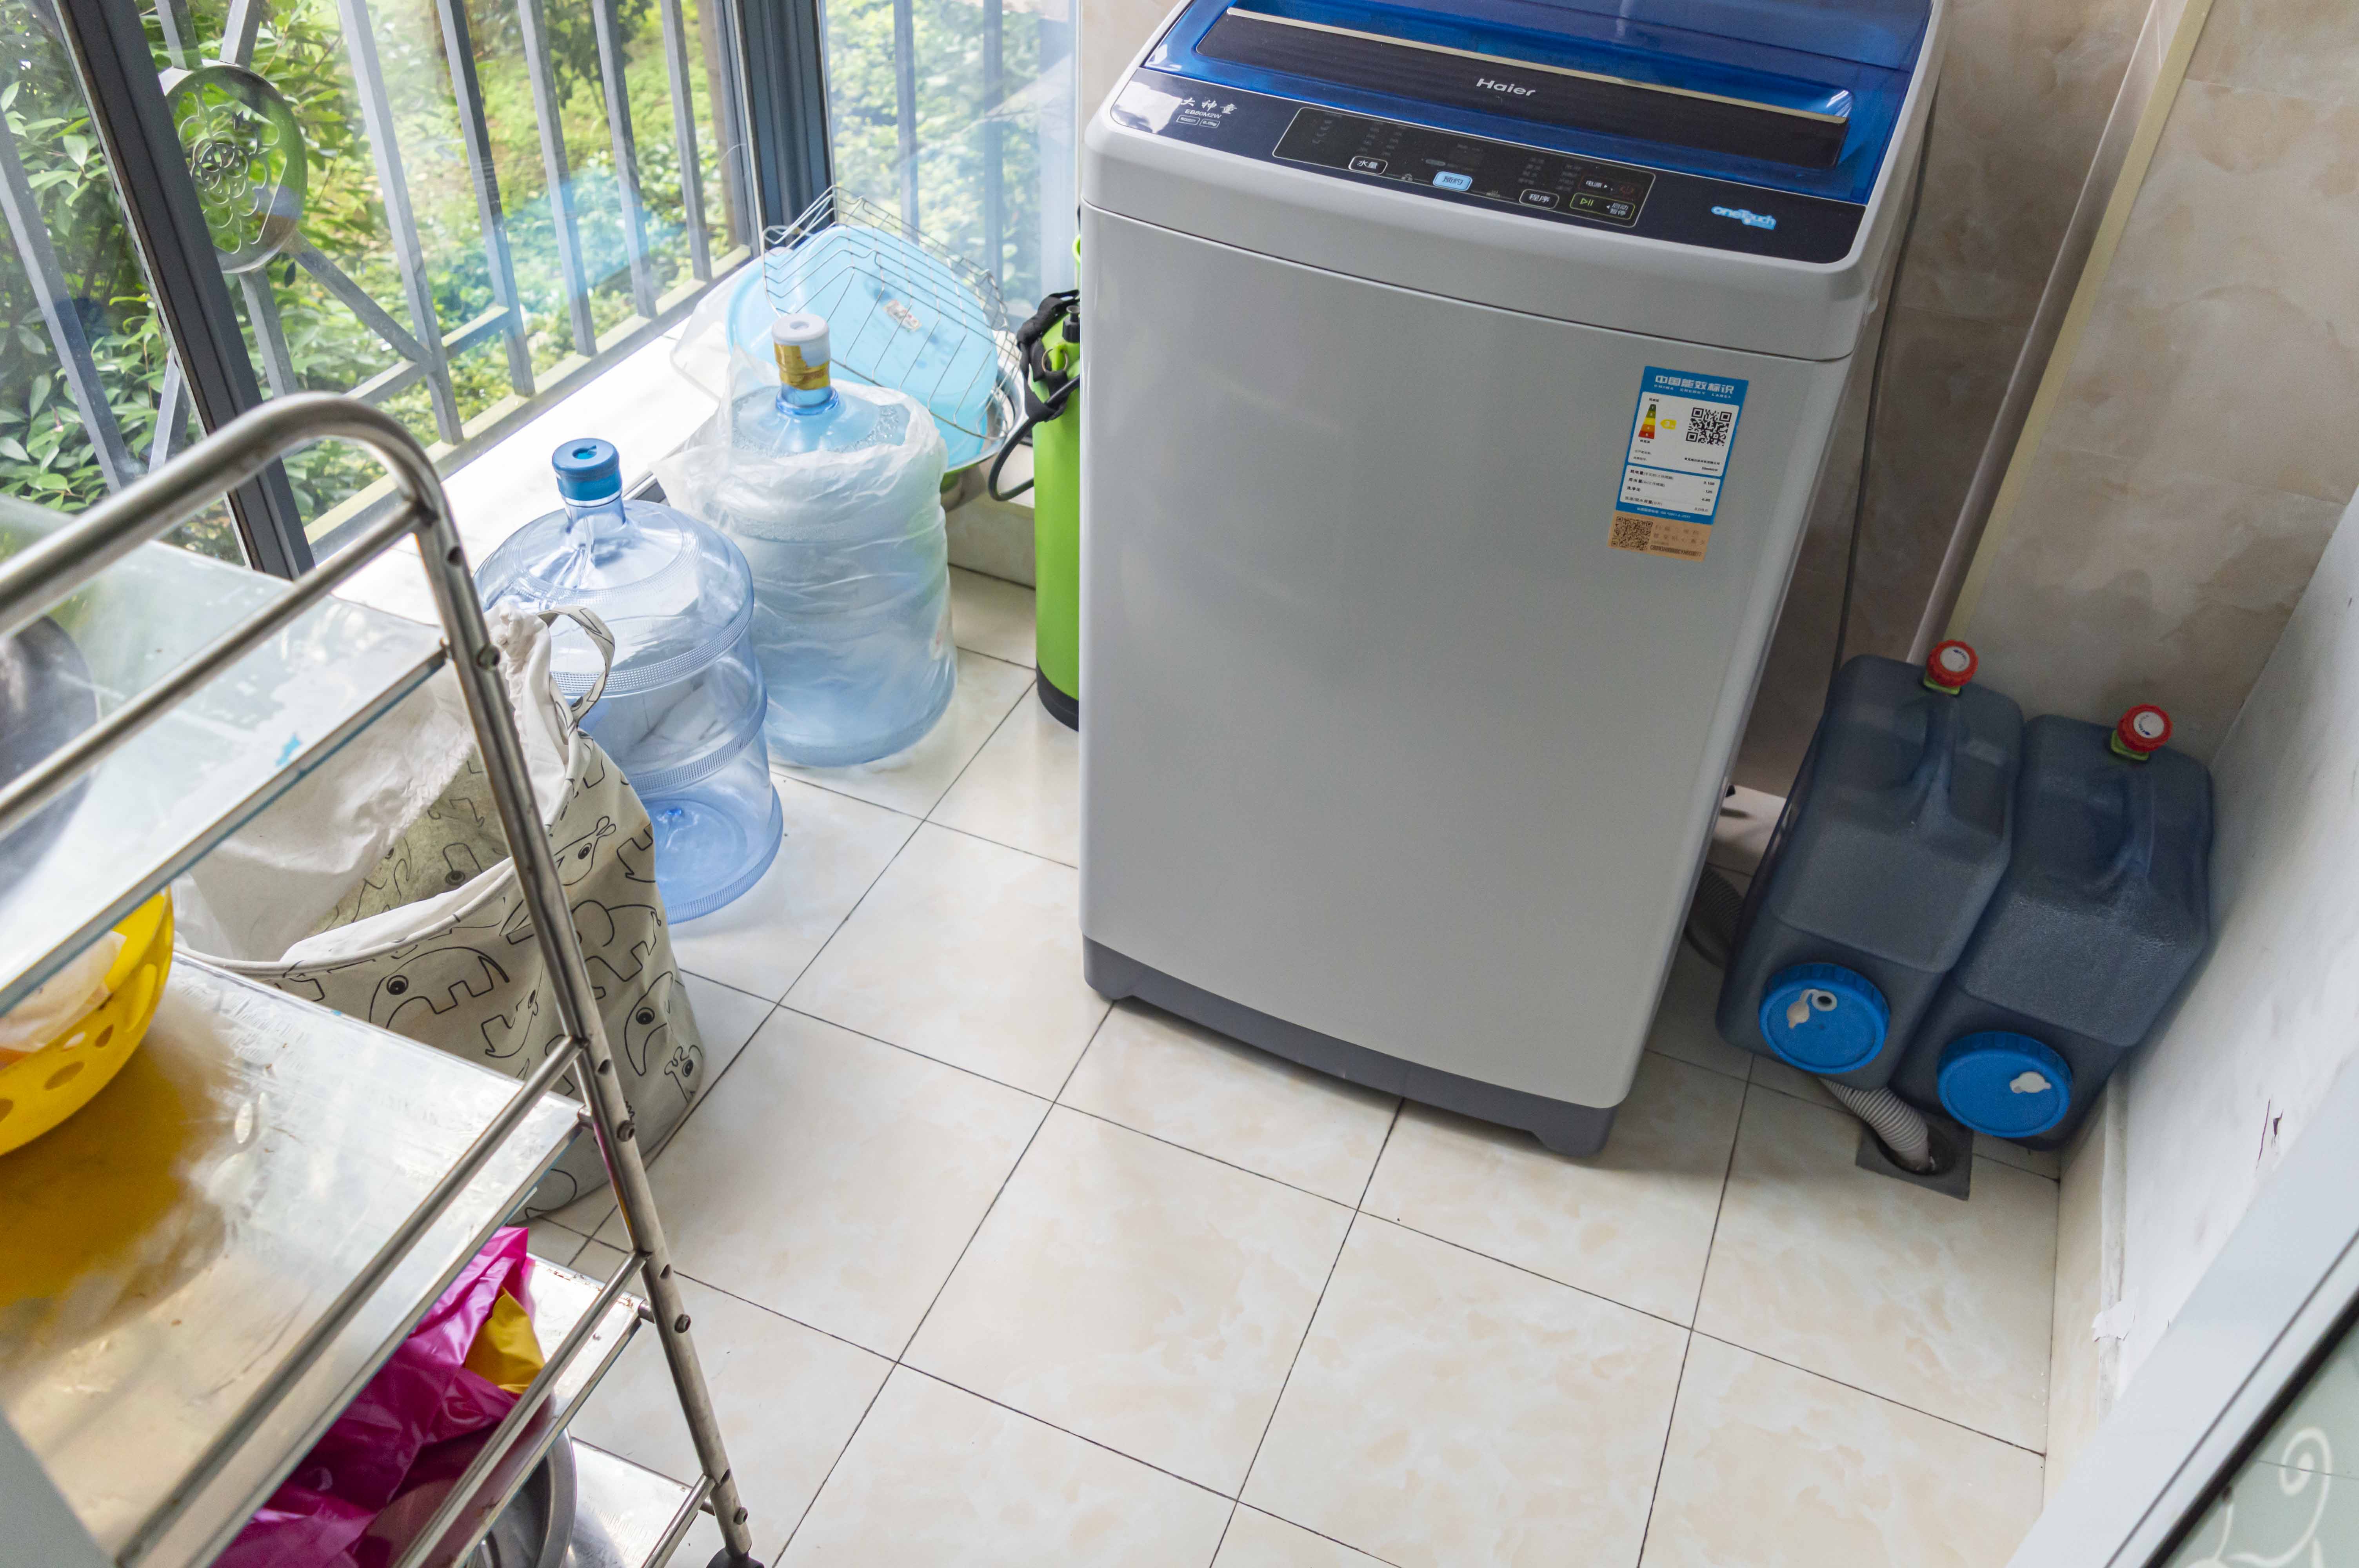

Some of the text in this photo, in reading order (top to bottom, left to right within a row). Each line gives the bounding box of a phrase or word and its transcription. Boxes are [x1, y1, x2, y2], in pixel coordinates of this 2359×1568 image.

[1476, 78, 1536, 96] Haier
[1185, 109, 1222, 119] EB80M2W
[1357, 160, 1378, 169] 水量
[1443, 175, 1463, 185] 预约
[1529, 193, 1550, 203] 程序
[1655, 375, 1735, 394] 中国能效标识
